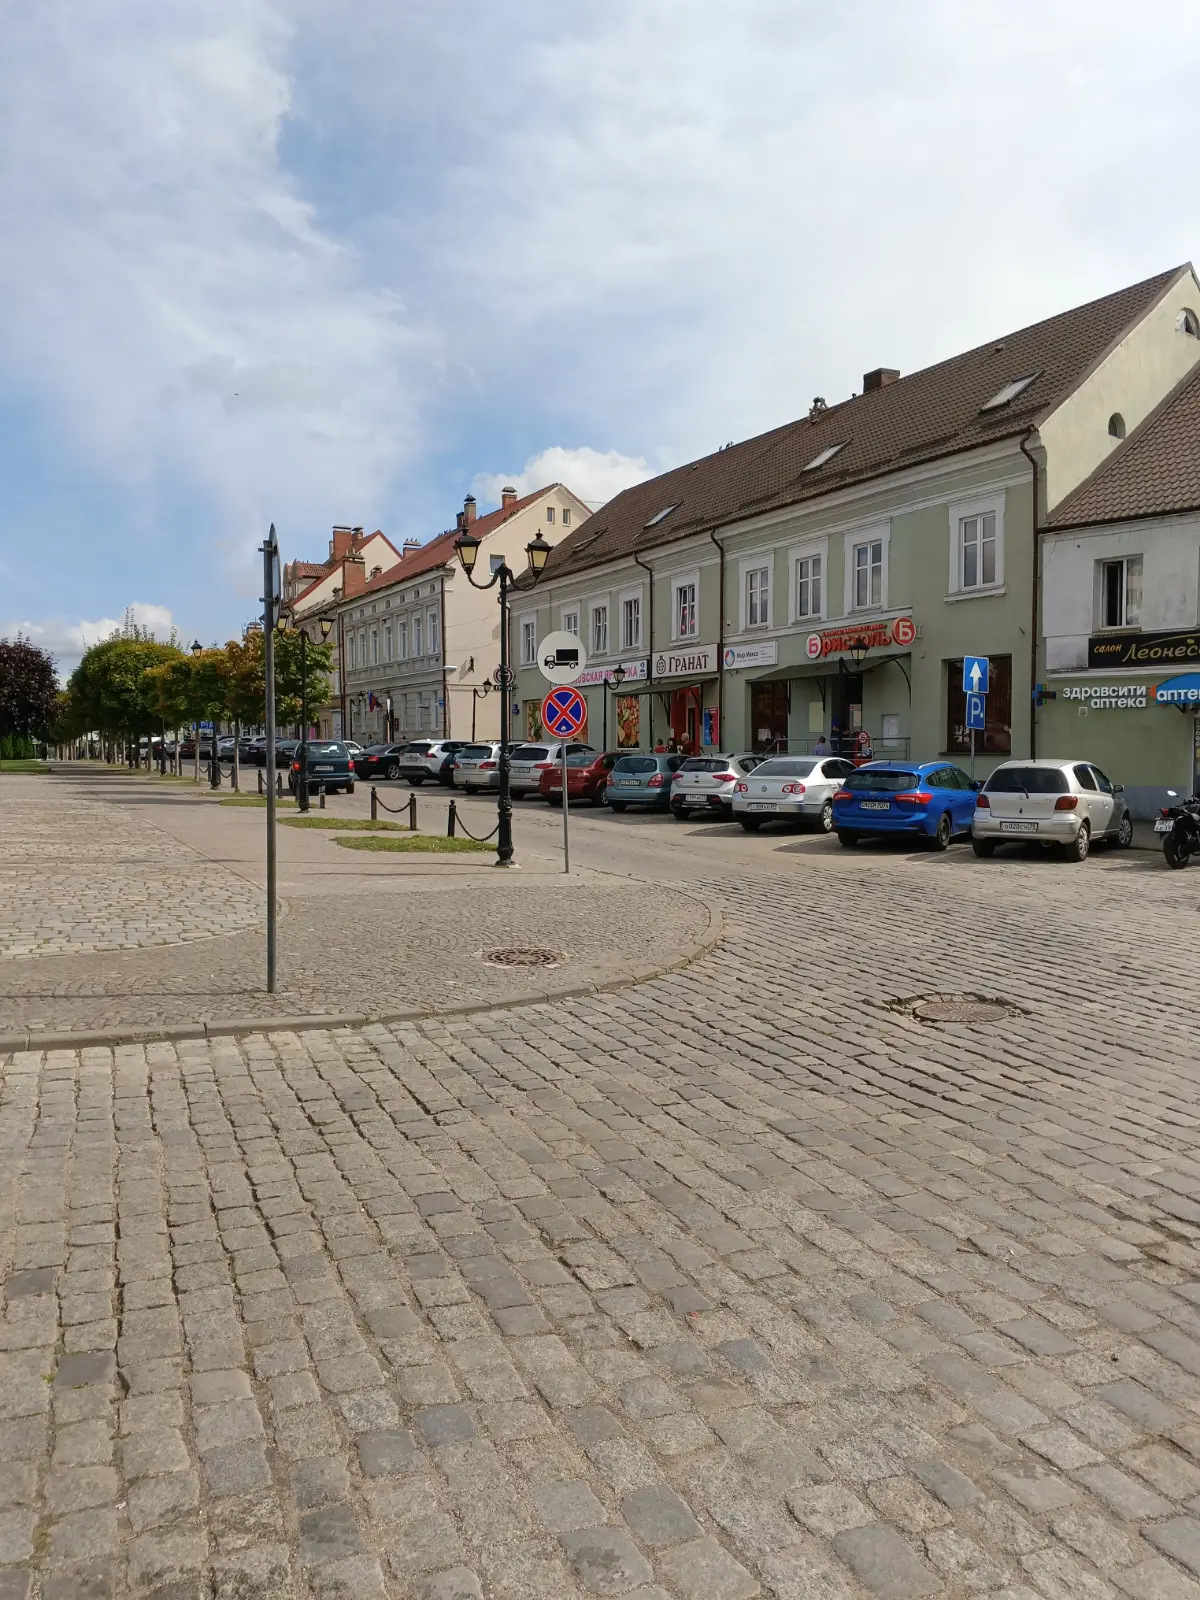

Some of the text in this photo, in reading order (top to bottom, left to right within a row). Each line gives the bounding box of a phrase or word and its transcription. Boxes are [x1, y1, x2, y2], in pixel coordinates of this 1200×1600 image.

[899, 622, 912, 640] Б
[1094, 643, 1200, 662] салон Леонес
[640, 662, 646, 672] 2
[669, 655, 709, 672] ГРАНАТ
[604, 666, 638, 680] ЯРРКА
[1063, 685, 1147, 700] здравсити
[1157, 689, 1200, 701] апте
[1091, 697, 1147, 708] аптека
